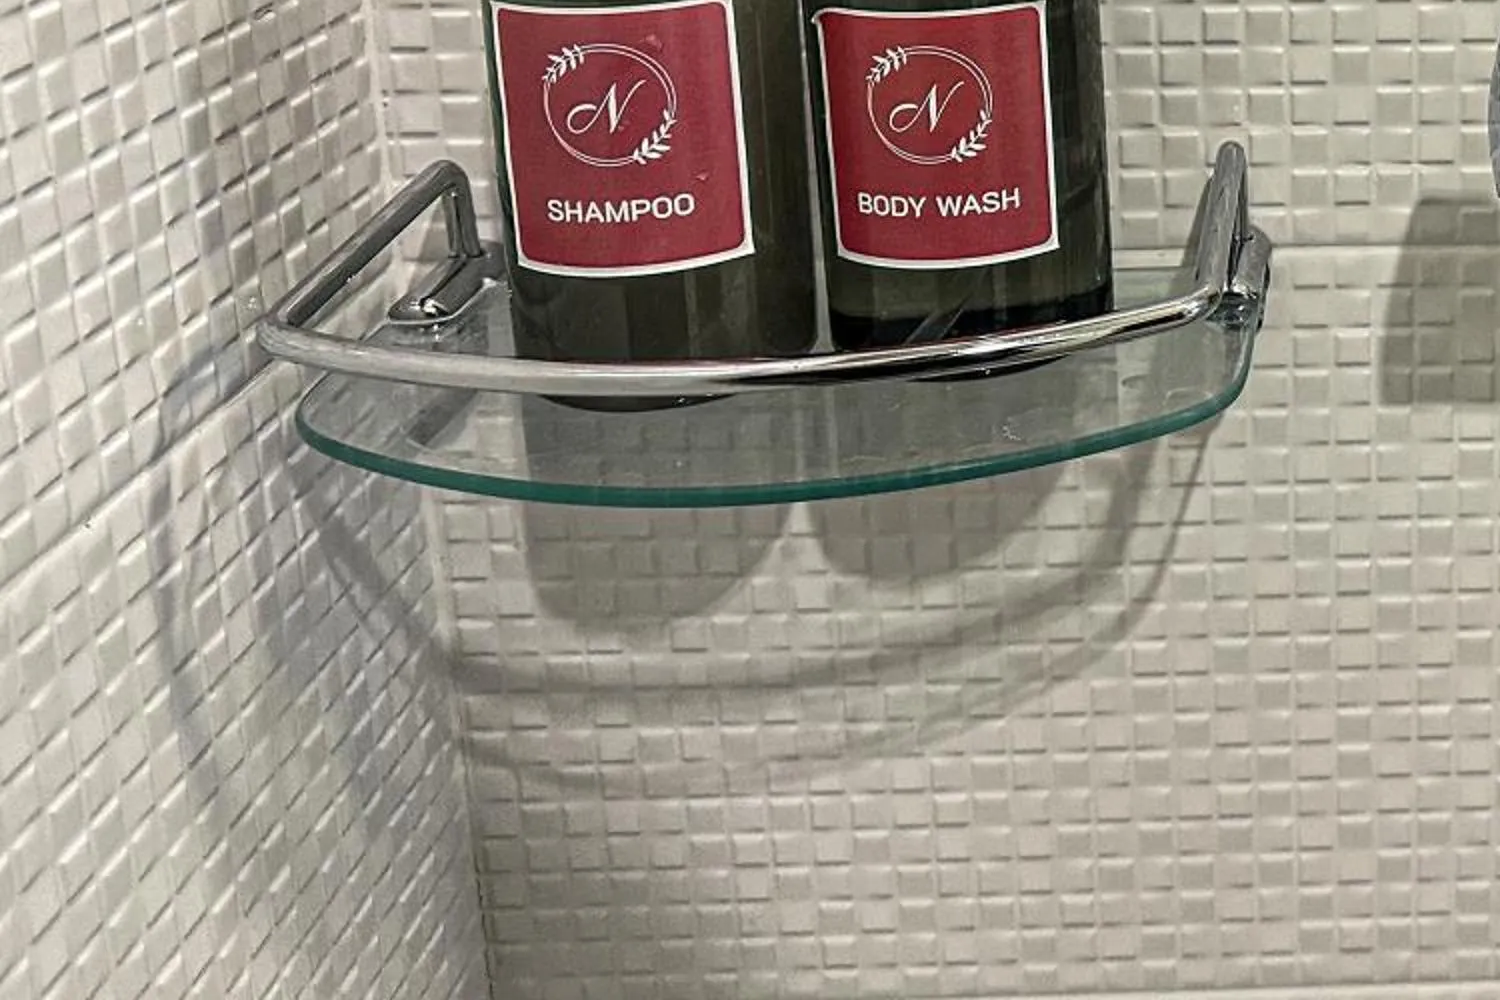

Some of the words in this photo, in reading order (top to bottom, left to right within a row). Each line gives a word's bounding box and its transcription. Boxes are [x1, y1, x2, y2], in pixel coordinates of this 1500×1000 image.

[566, 78, 647, 135] N
[889, 80, 965, 133] N
[546, 193, 696, 224] SHAMPOO
[857, 191, 927, 219] BODY
[935, 187, 1021, 218] WASH
